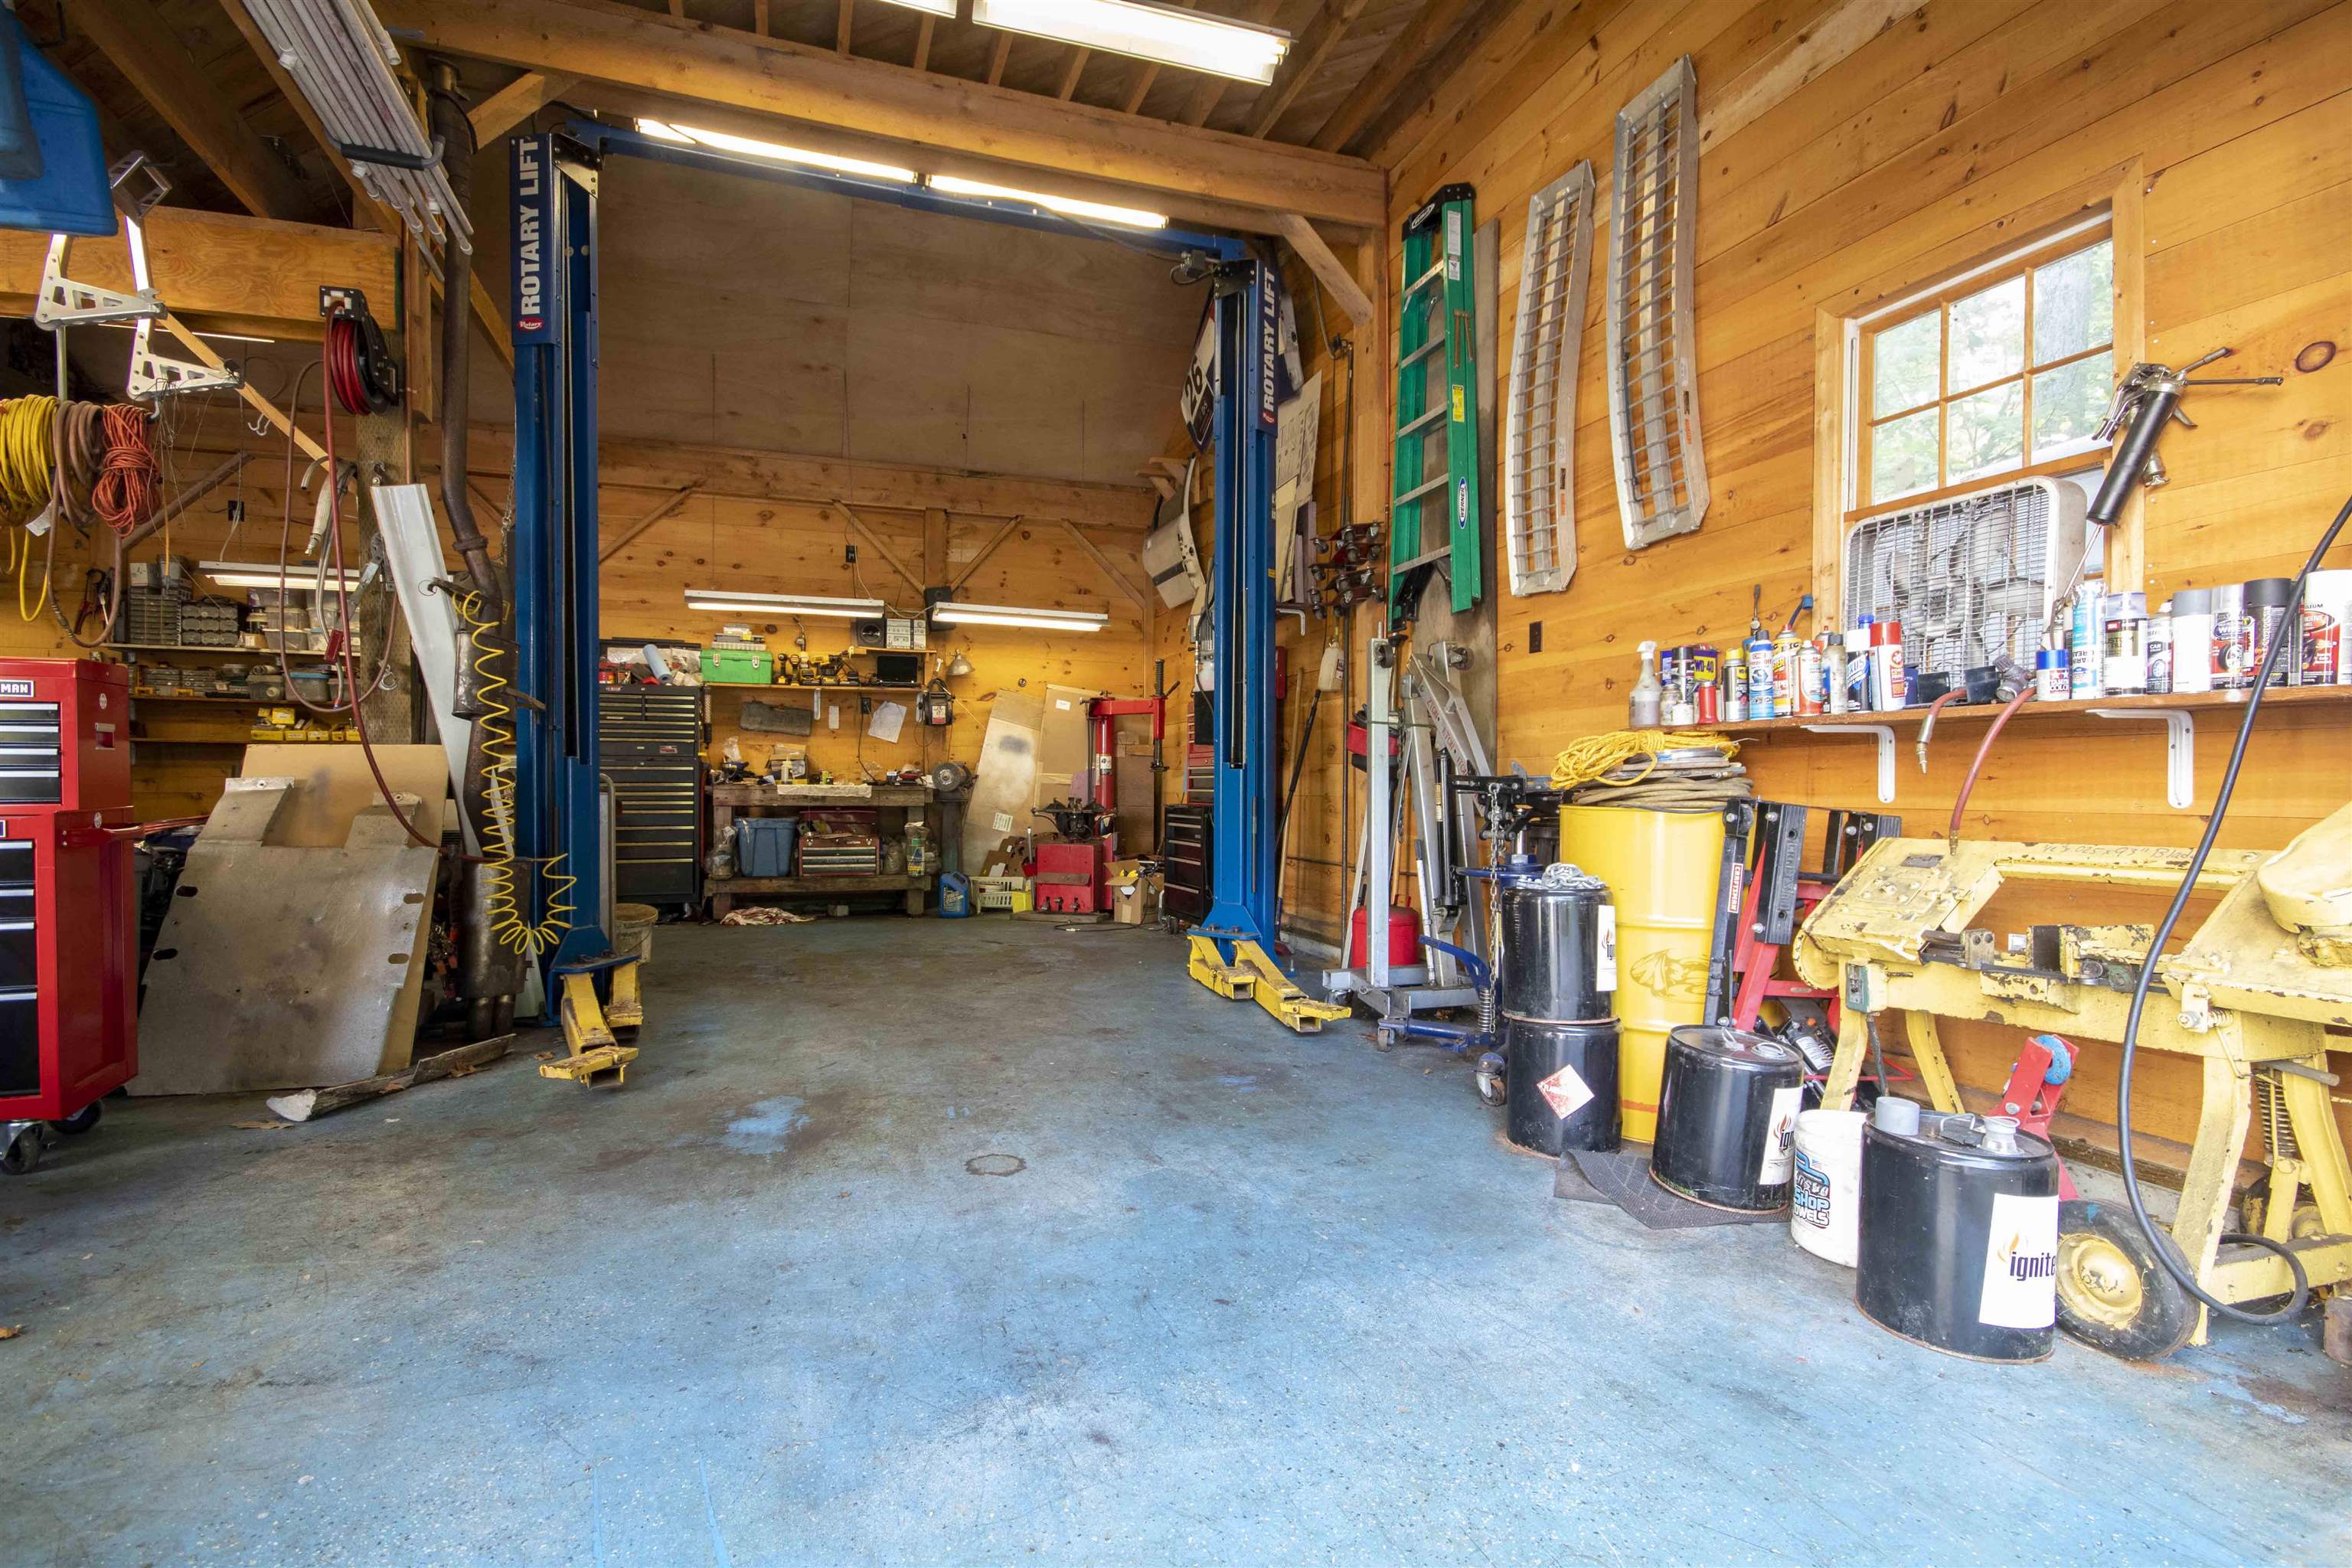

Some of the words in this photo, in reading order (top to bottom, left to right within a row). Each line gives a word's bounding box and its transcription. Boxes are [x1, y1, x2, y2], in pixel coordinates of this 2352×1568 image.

[519, 139, 539, 196] LIFT
[520, 205, 540, 315] ROTARY
[1264, 267, 1275, 316] LIFT
[1264, 318, 1275, 413] ROTARY
[1694, 658, 1714, 673] WD-40
[1730, 865, 1742, 911] CRAFTSMAN
[1794, 1187, 1830, 1210] SHOP
[2010, 1252, 2056, 1282] ignite
